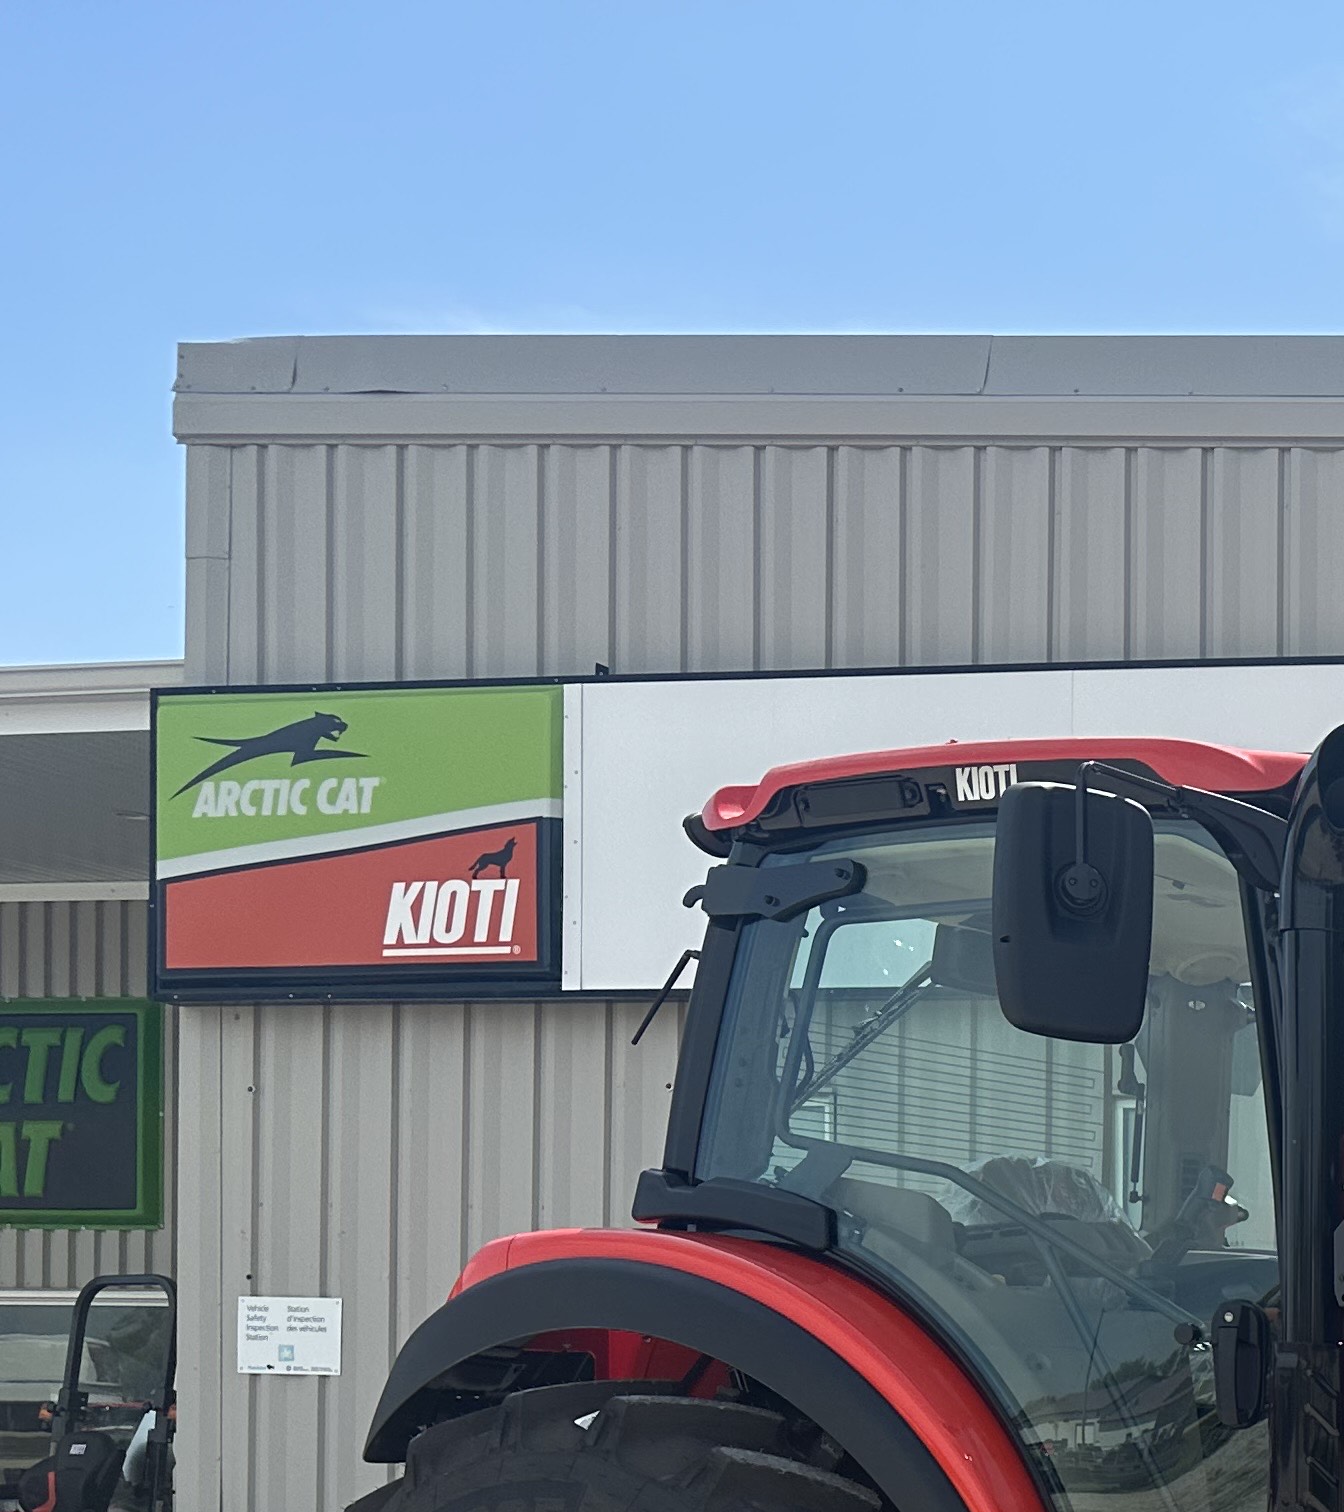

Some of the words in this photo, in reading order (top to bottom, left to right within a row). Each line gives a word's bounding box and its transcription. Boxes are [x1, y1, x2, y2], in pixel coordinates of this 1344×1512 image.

[192, 779, 311, 818] ARCTIC
[316, 777, 381, 815] CAT
[955, 763, 1019, 802] KIOTI
[382, 878, 520, 945] KIOTI
